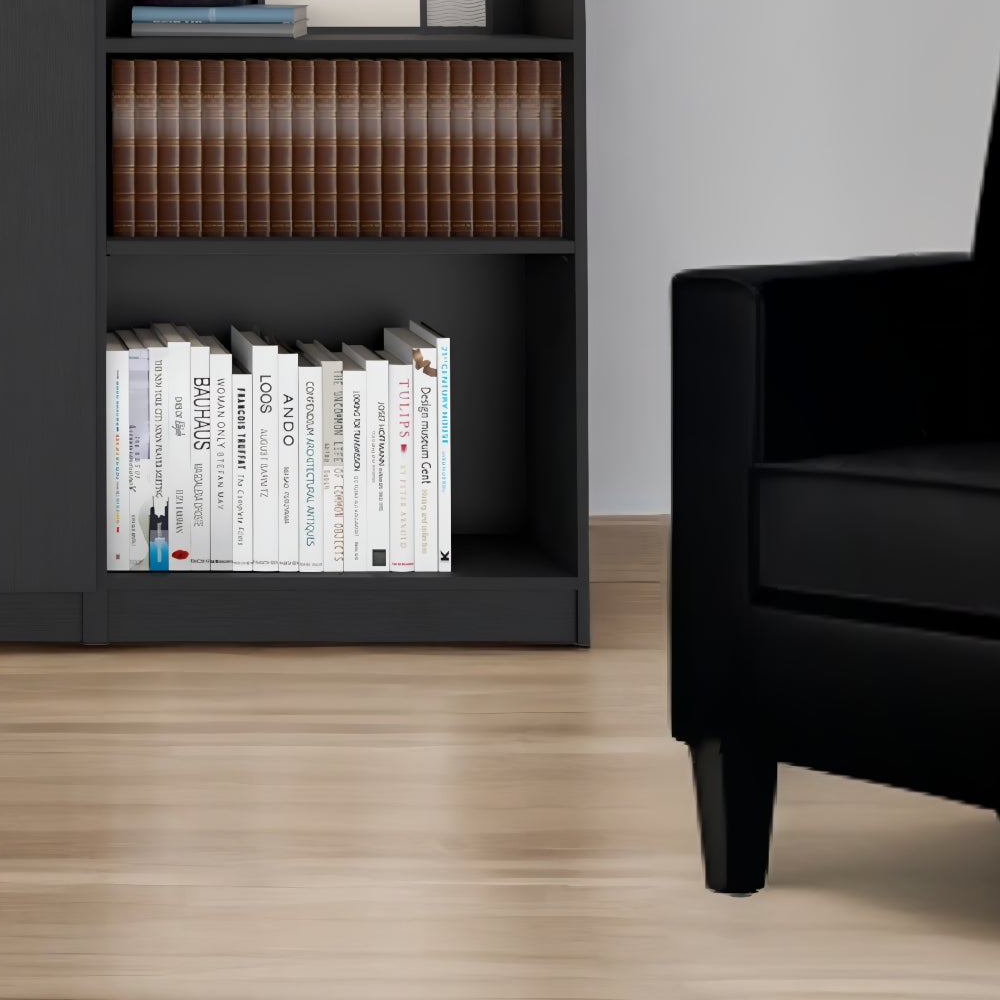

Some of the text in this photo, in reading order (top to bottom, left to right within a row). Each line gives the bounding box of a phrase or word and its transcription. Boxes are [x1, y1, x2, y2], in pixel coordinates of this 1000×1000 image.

[260, 375, 272, 413] LOOS
[399, 379, 410, 438] TULIPS
[418, 387, 431, 418] Design
[194, 378, 210, 450] BAUHAUS
[283, 394, 294, 446] ANDO
[217, 422, 225, 448] ONLY
[421, 421, 430, 458] museum
[421, 462, 431, 484] Gent
[334, 523, 343, 561] OBJECTS
